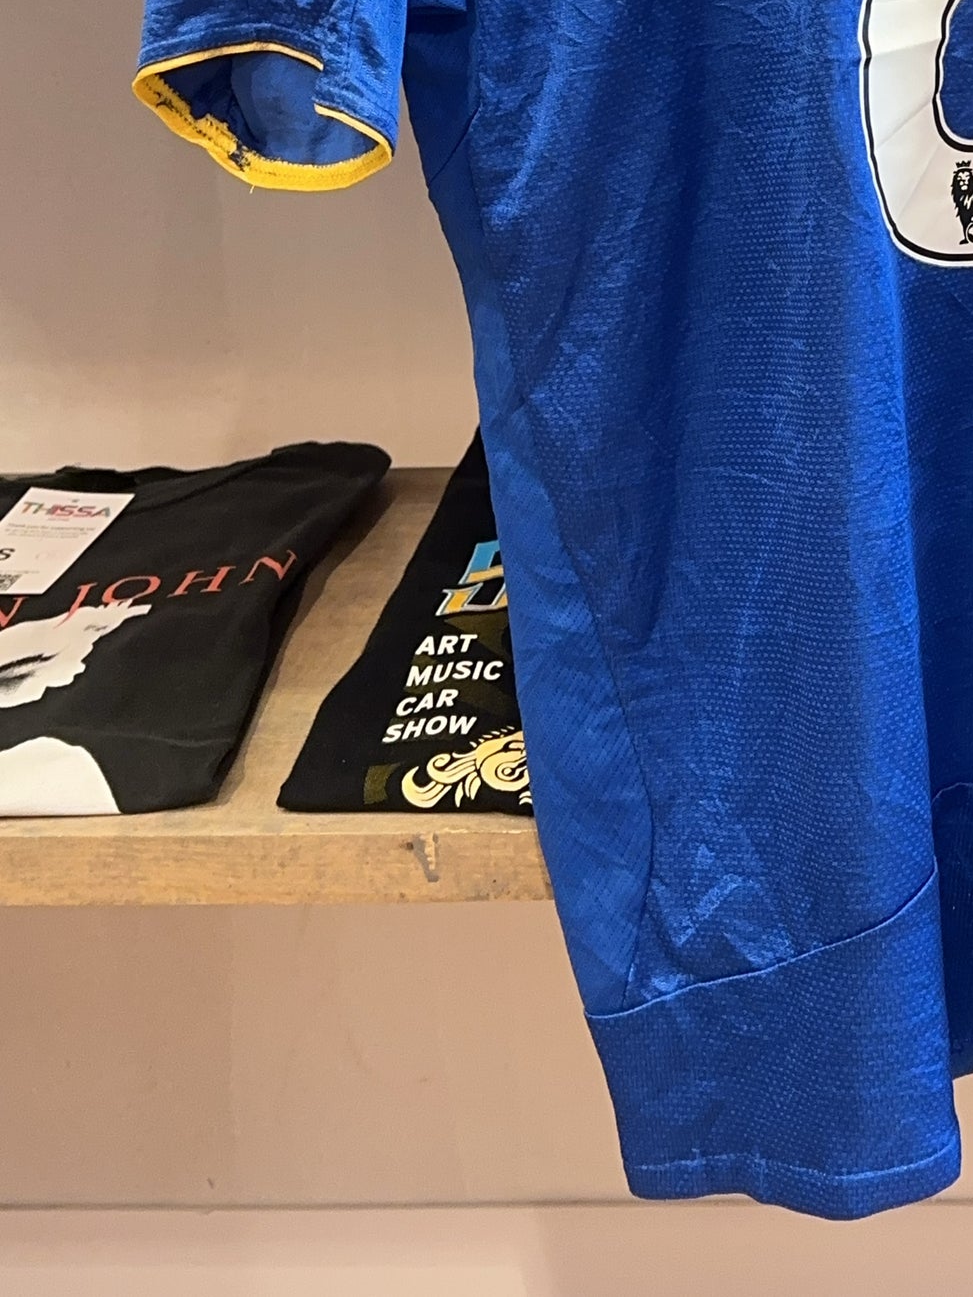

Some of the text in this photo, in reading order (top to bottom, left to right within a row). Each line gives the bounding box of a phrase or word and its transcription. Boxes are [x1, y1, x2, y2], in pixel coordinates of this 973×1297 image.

[53, 550, 298, 629] JOHN
[415, 634, 478, 656] ART
[405, 660, 504, 687] MUSIC
[395, 688, 459, 717] CAR
[381, 715, 477, 743] SHOW
